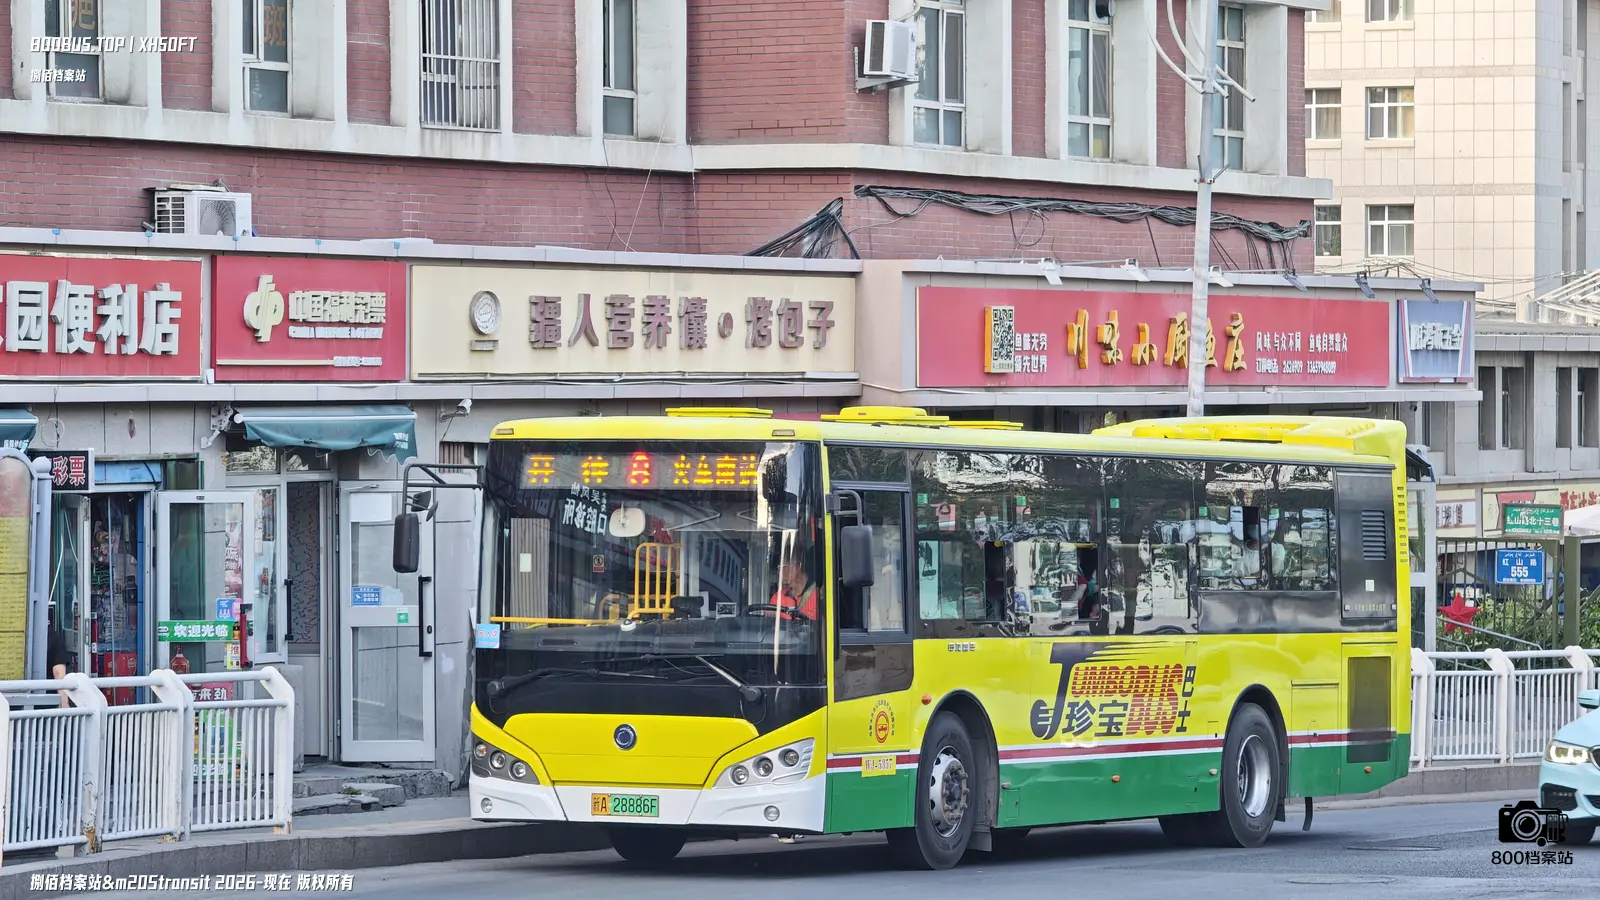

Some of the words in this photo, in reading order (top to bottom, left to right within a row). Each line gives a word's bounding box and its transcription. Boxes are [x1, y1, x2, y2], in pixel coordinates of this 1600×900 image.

[0, 279, 182, 355] 园便利店
[1510, 566, 1529, 577] 555
[174, 622, 229, 638] 欢迎光临
[1061, 699, 1129, 738] 珍宝
[613, 797, 657, 813] 28886F
